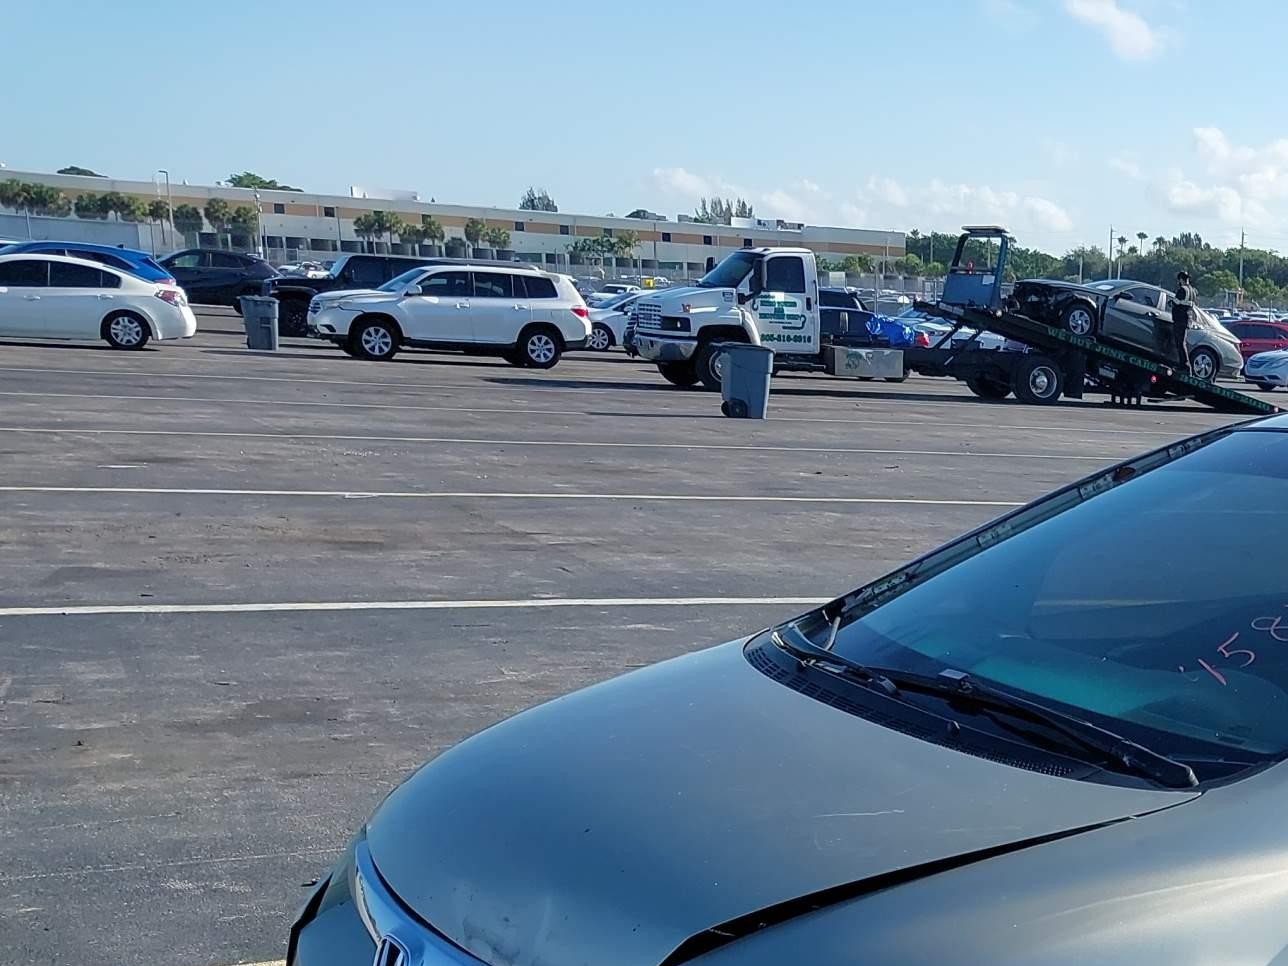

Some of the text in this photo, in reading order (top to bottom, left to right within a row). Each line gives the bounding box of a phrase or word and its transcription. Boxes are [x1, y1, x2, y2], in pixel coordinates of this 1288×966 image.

[1047, 328, 1158, 372] WE BUY JUNK CARS
